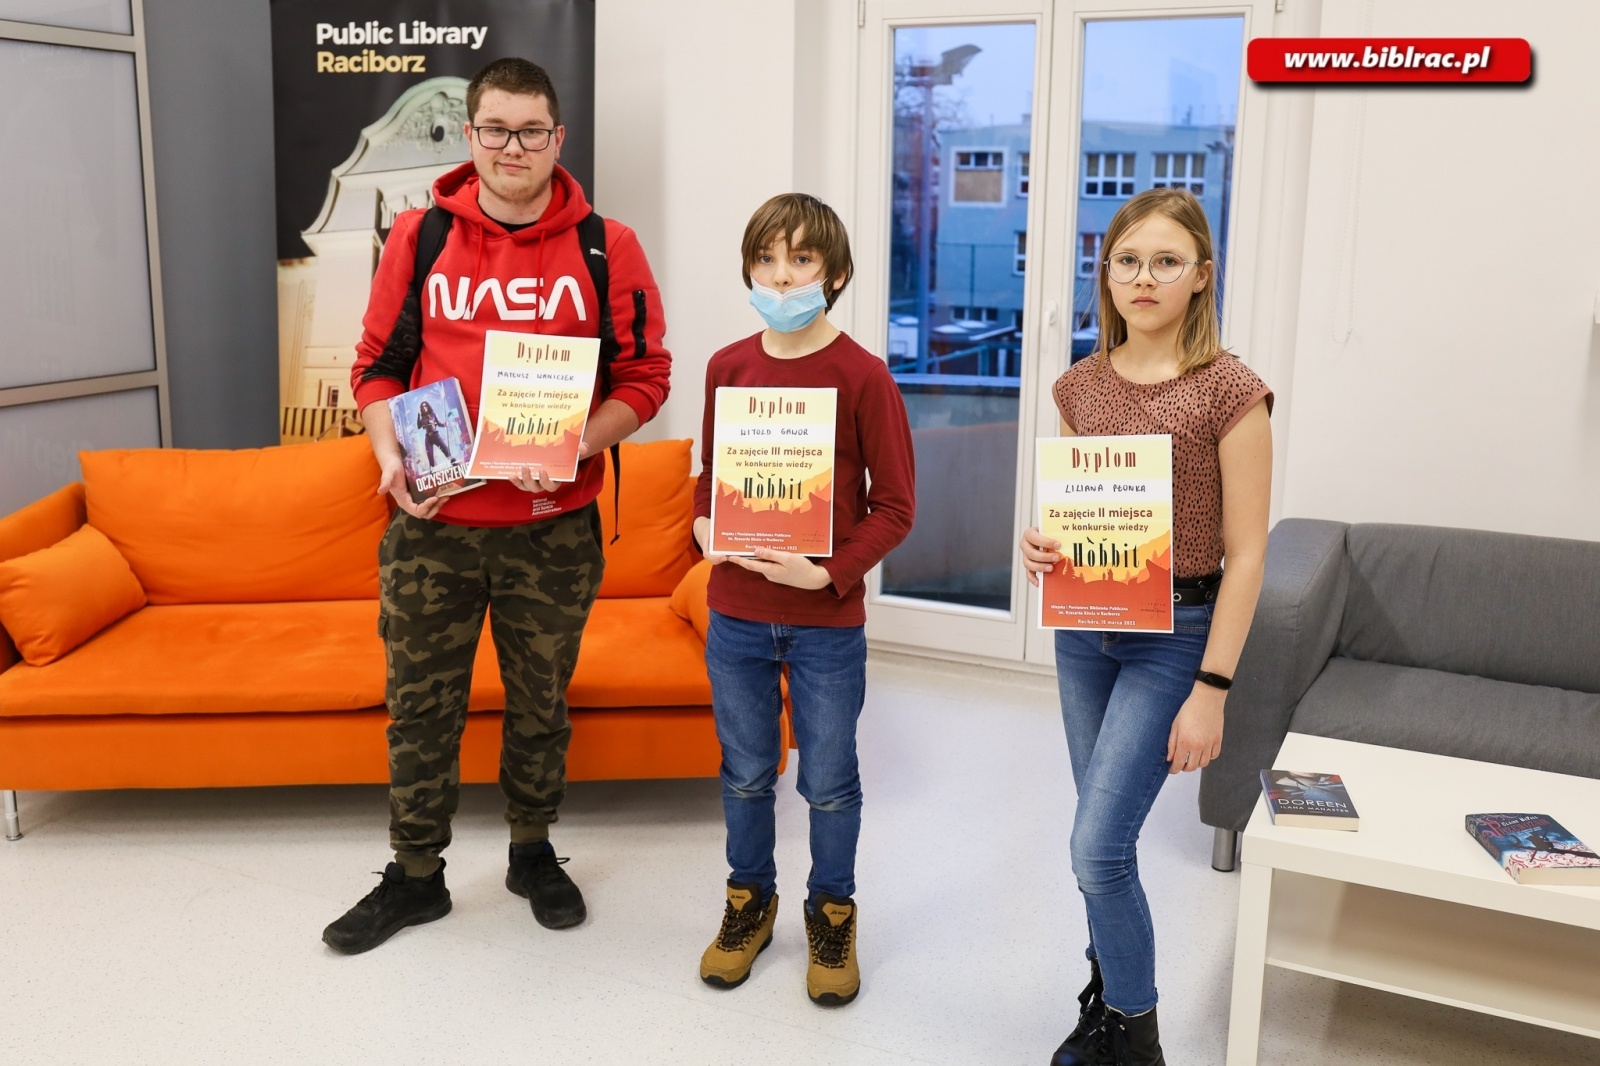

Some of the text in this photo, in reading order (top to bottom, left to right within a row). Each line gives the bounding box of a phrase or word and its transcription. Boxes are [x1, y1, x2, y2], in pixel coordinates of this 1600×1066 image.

[316, 20, 488, 50] Public Library
[317, 49, 426, 72] Raciborz
[428, 272, 586, 321] NASA
[517, 342, 570, 363] Dyplom
[498, 371, 529, 379] MATEUSZ
[509, 390, 535, 399] zajęcie
[544, 391, 579, 400] miejsca
[749, 396, 806, 418] Dyplom
[506, 417, 559, 435] Hobbit
[740, 448, 768, 456] zajęcie
[771, 447, 780, 455] III
[784, 447, 822, 458] miejsca
[1072, 447, 1136, 473] Dyplom
[786, 461, 813, 469] wiedzy
[744, 477, 804, 500] Hobbit
[1065, 484, 1146, 493] LILIANA PŁONKA
[1049, 508, 1153, 520] Za zajęcie II miejsca
[1118, 523, 1148, 532] wiedzy
[1073, 543, 1140, 568] Hobbit
[1278, 799, 1347, 808] DOREEN
